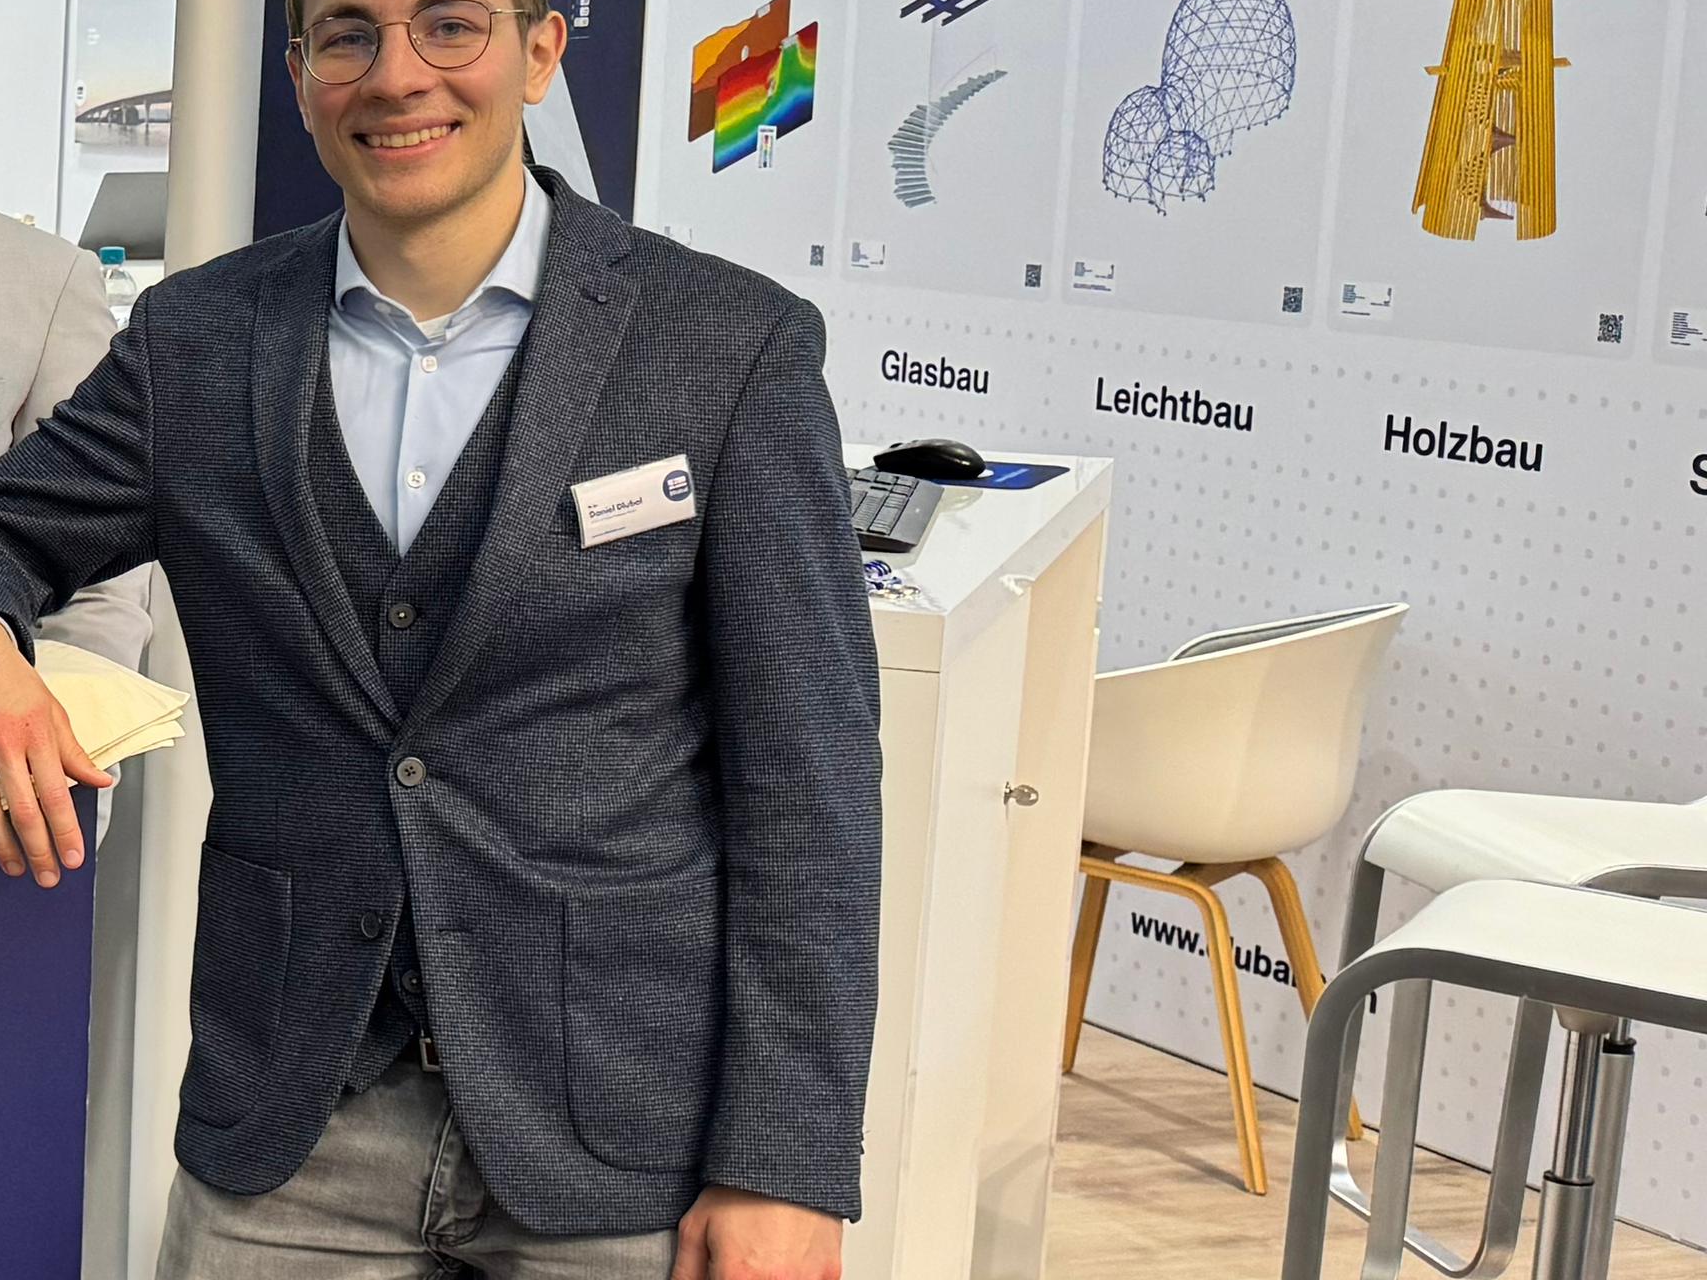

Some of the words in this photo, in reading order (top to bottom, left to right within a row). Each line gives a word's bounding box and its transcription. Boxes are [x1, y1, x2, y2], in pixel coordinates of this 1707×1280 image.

[881, 349, 989, 395] Glasbau
[1095, 377, 1254, 432] Leichtbau
[1384, 414, 1543, 472] Holzbau
